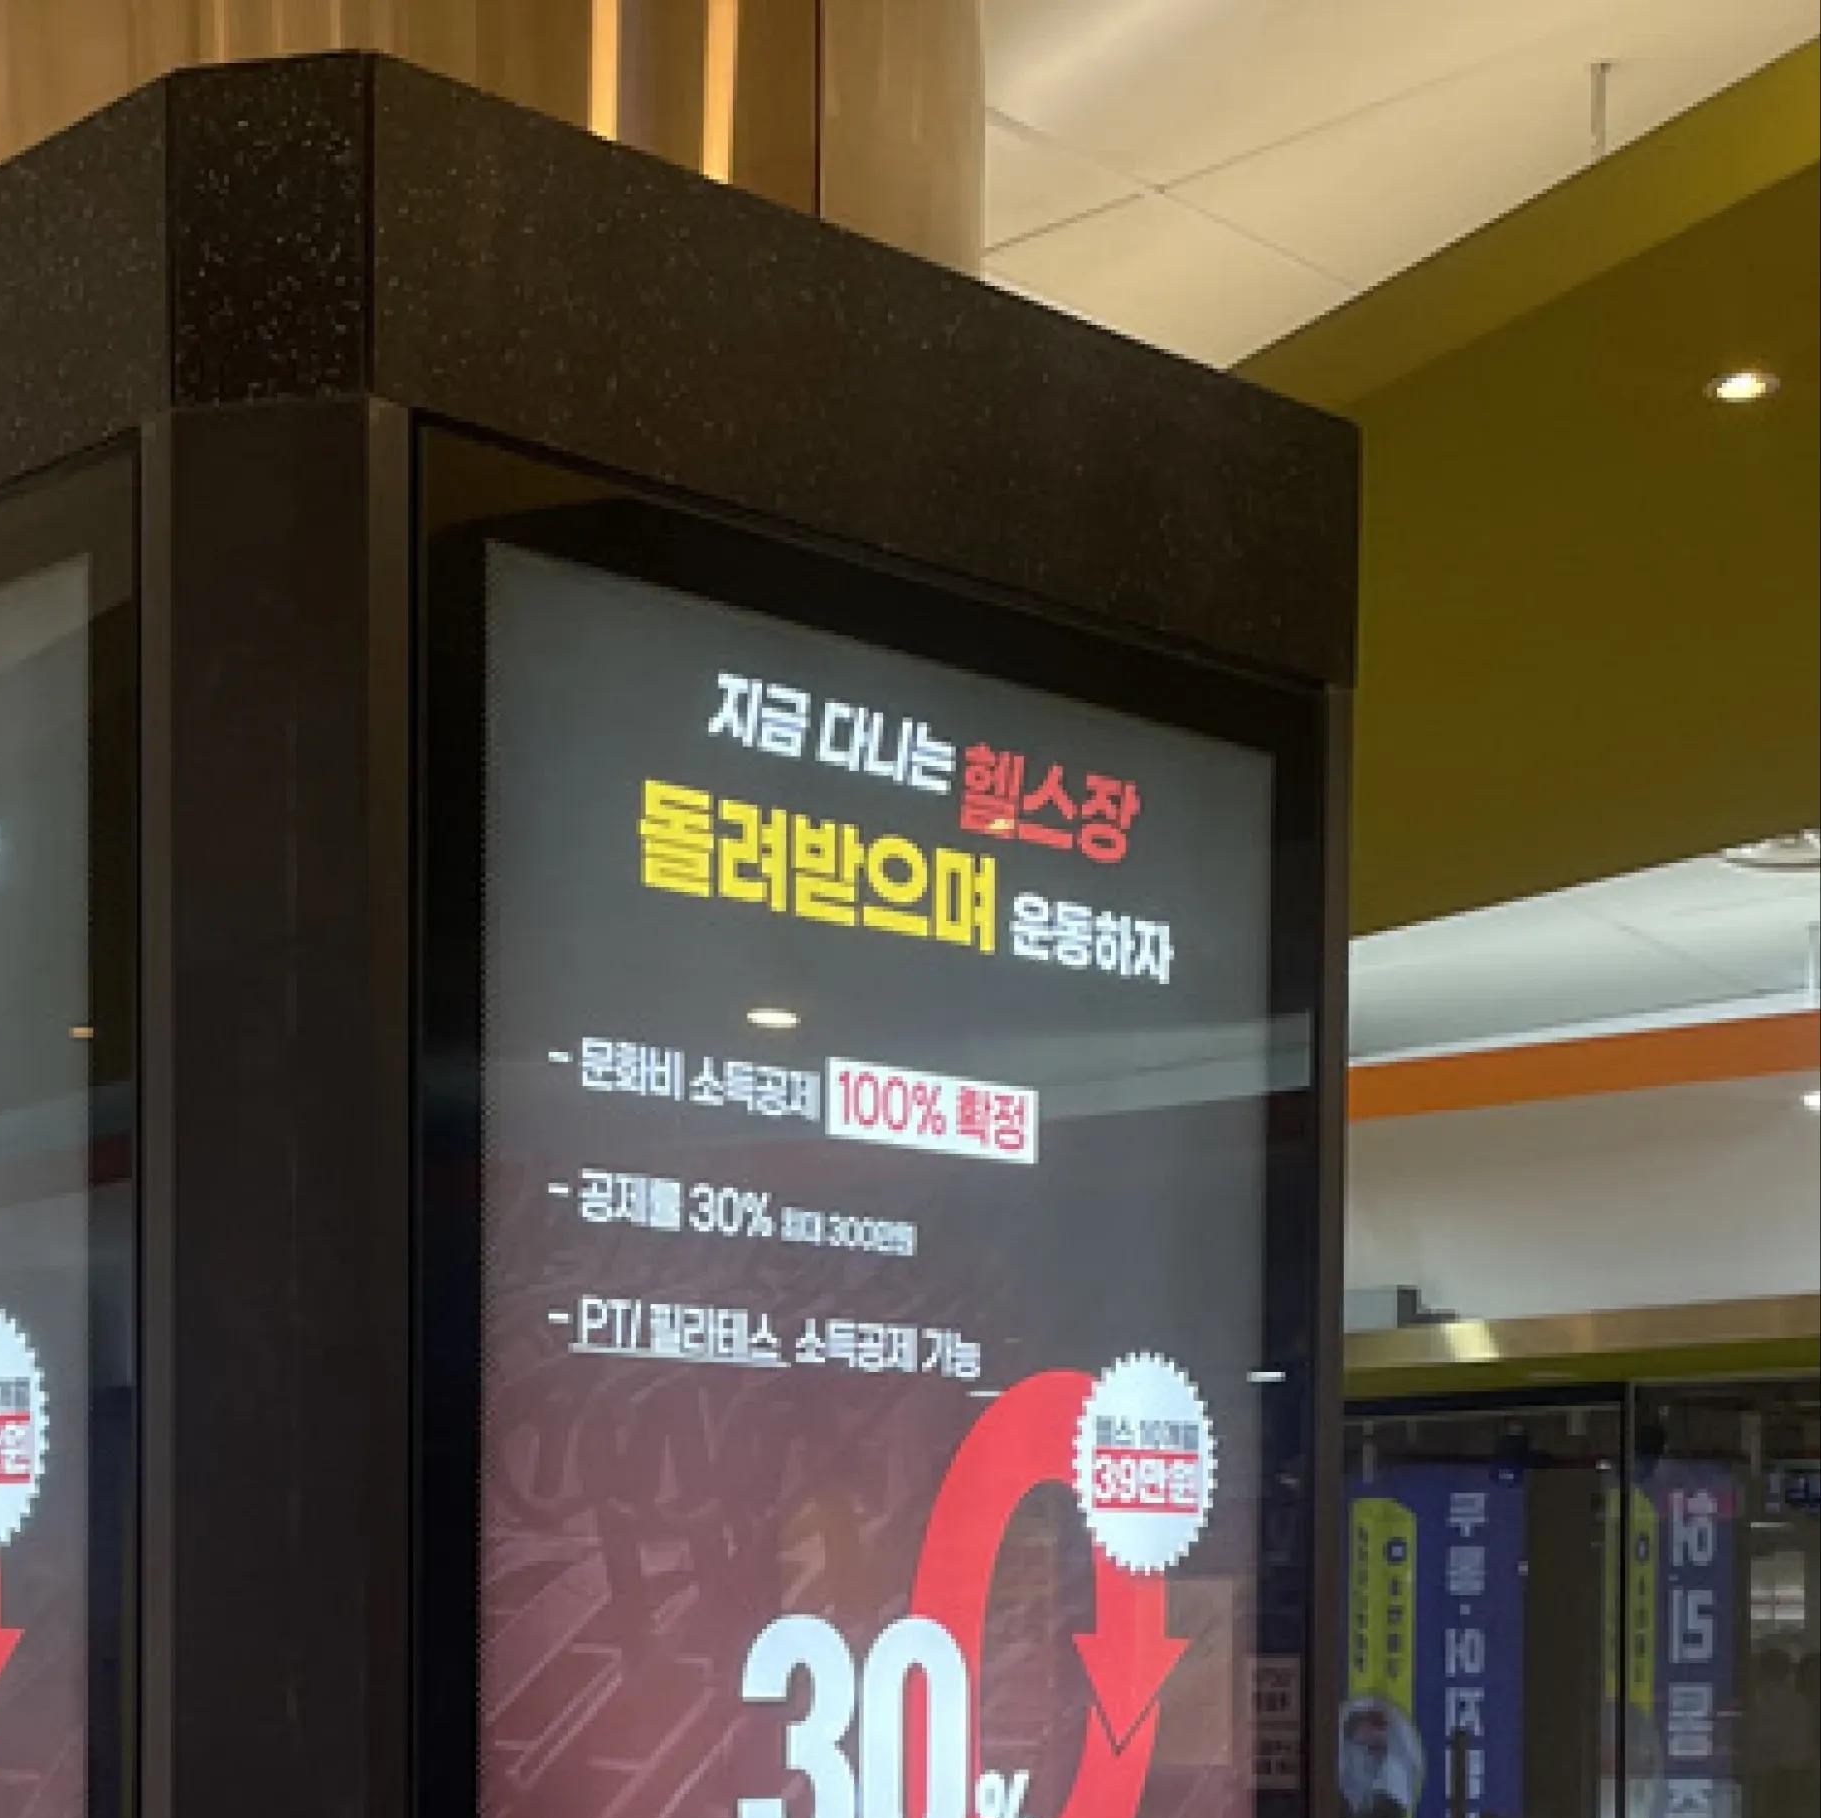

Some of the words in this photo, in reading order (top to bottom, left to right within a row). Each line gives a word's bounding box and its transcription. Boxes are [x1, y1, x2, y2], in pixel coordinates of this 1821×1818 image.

[708, 672, 808, 759] 지금
[819, 700, 957, 796] 다니는
[961, 743, 1140, 864] 헬스장
[639, 779, 997, 954] 돌려받으며
[1009, 890, 1175, 984] 운동하자
[582, 1036, 685, 1101] 문화비
[689, 1056, 821, 1122] 소득공제
[838, 1070, 947, 1137] 100%
[955, 1085, 1026, 1151] 확정
[688, 1182, 776, 1238] 30%
[795, 1317, 918, 1374] 소득공제
[920, 1327, 981, 1379] 가능
